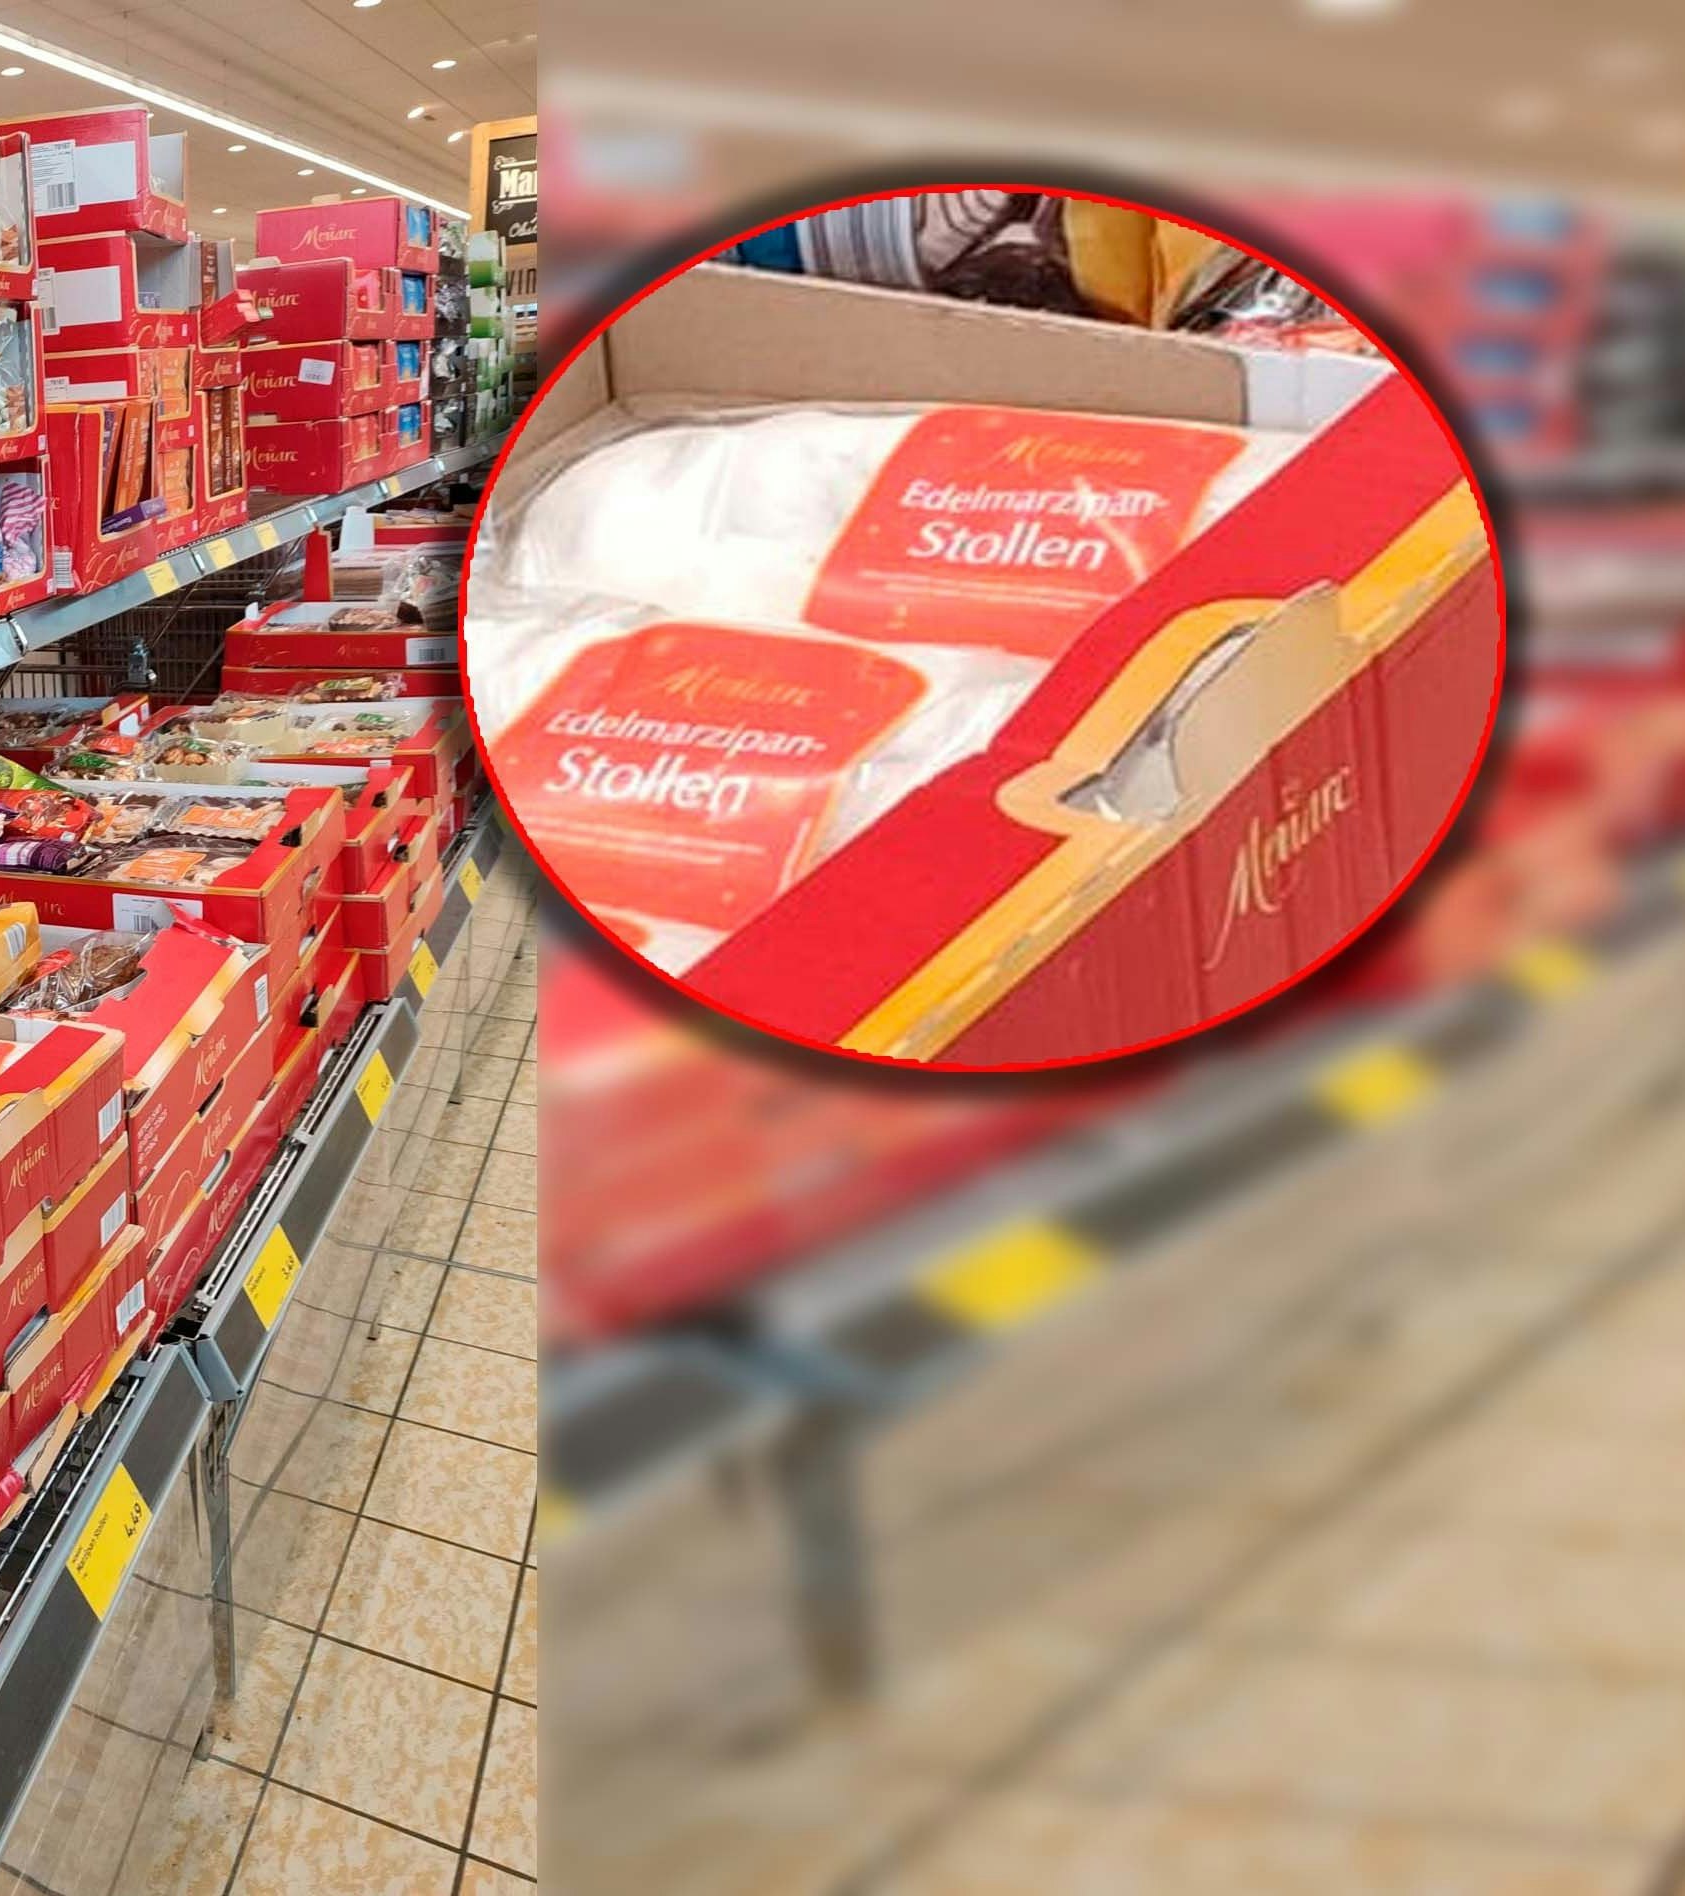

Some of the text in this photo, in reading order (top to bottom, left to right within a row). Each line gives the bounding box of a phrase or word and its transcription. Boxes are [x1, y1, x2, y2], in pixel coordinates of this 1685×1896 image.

[906, 518, 1110, 572] Stollen
[543, 705, 827, 759] Edelmarzipan-
[543, 745, 752, 816] Stollen
